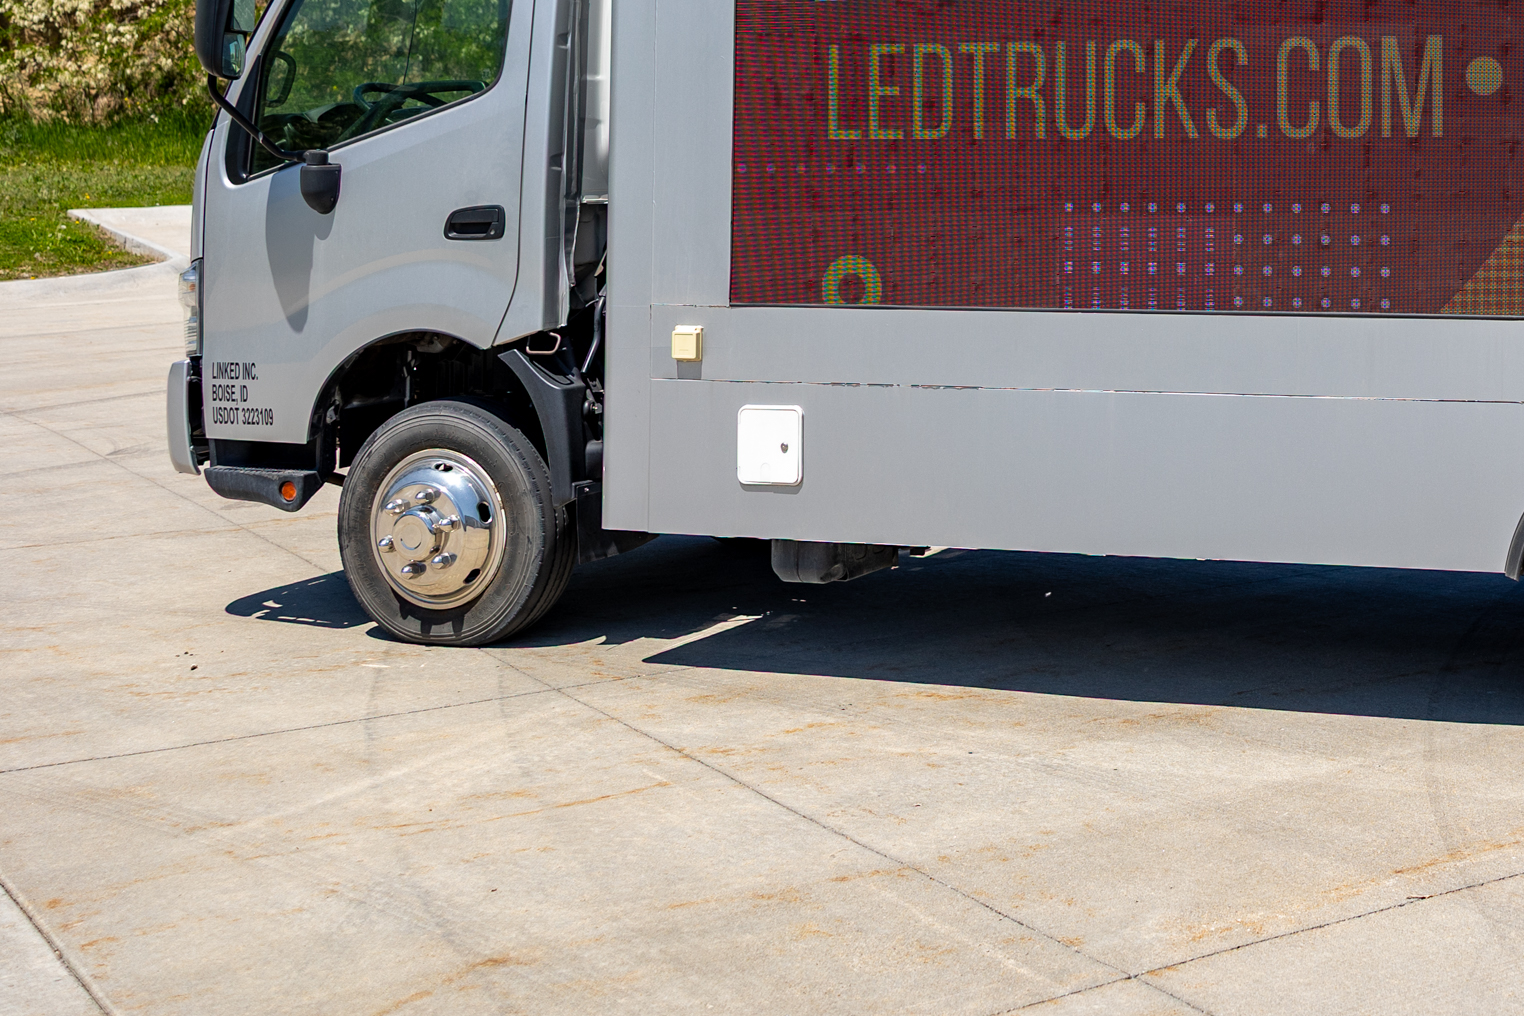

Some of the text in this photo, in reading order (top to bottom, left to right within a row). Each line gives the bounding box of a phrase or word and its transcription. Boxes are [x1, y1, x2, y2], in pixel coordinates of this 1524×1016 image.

[827, 34, 1445, 141] LEDTRUCKS.COM
[212, 362, 259, 380] LINKED INC.
[212, 384, 249, 405] BOISE, ID
[212, 407, 274, 426] USDOT 3223109
